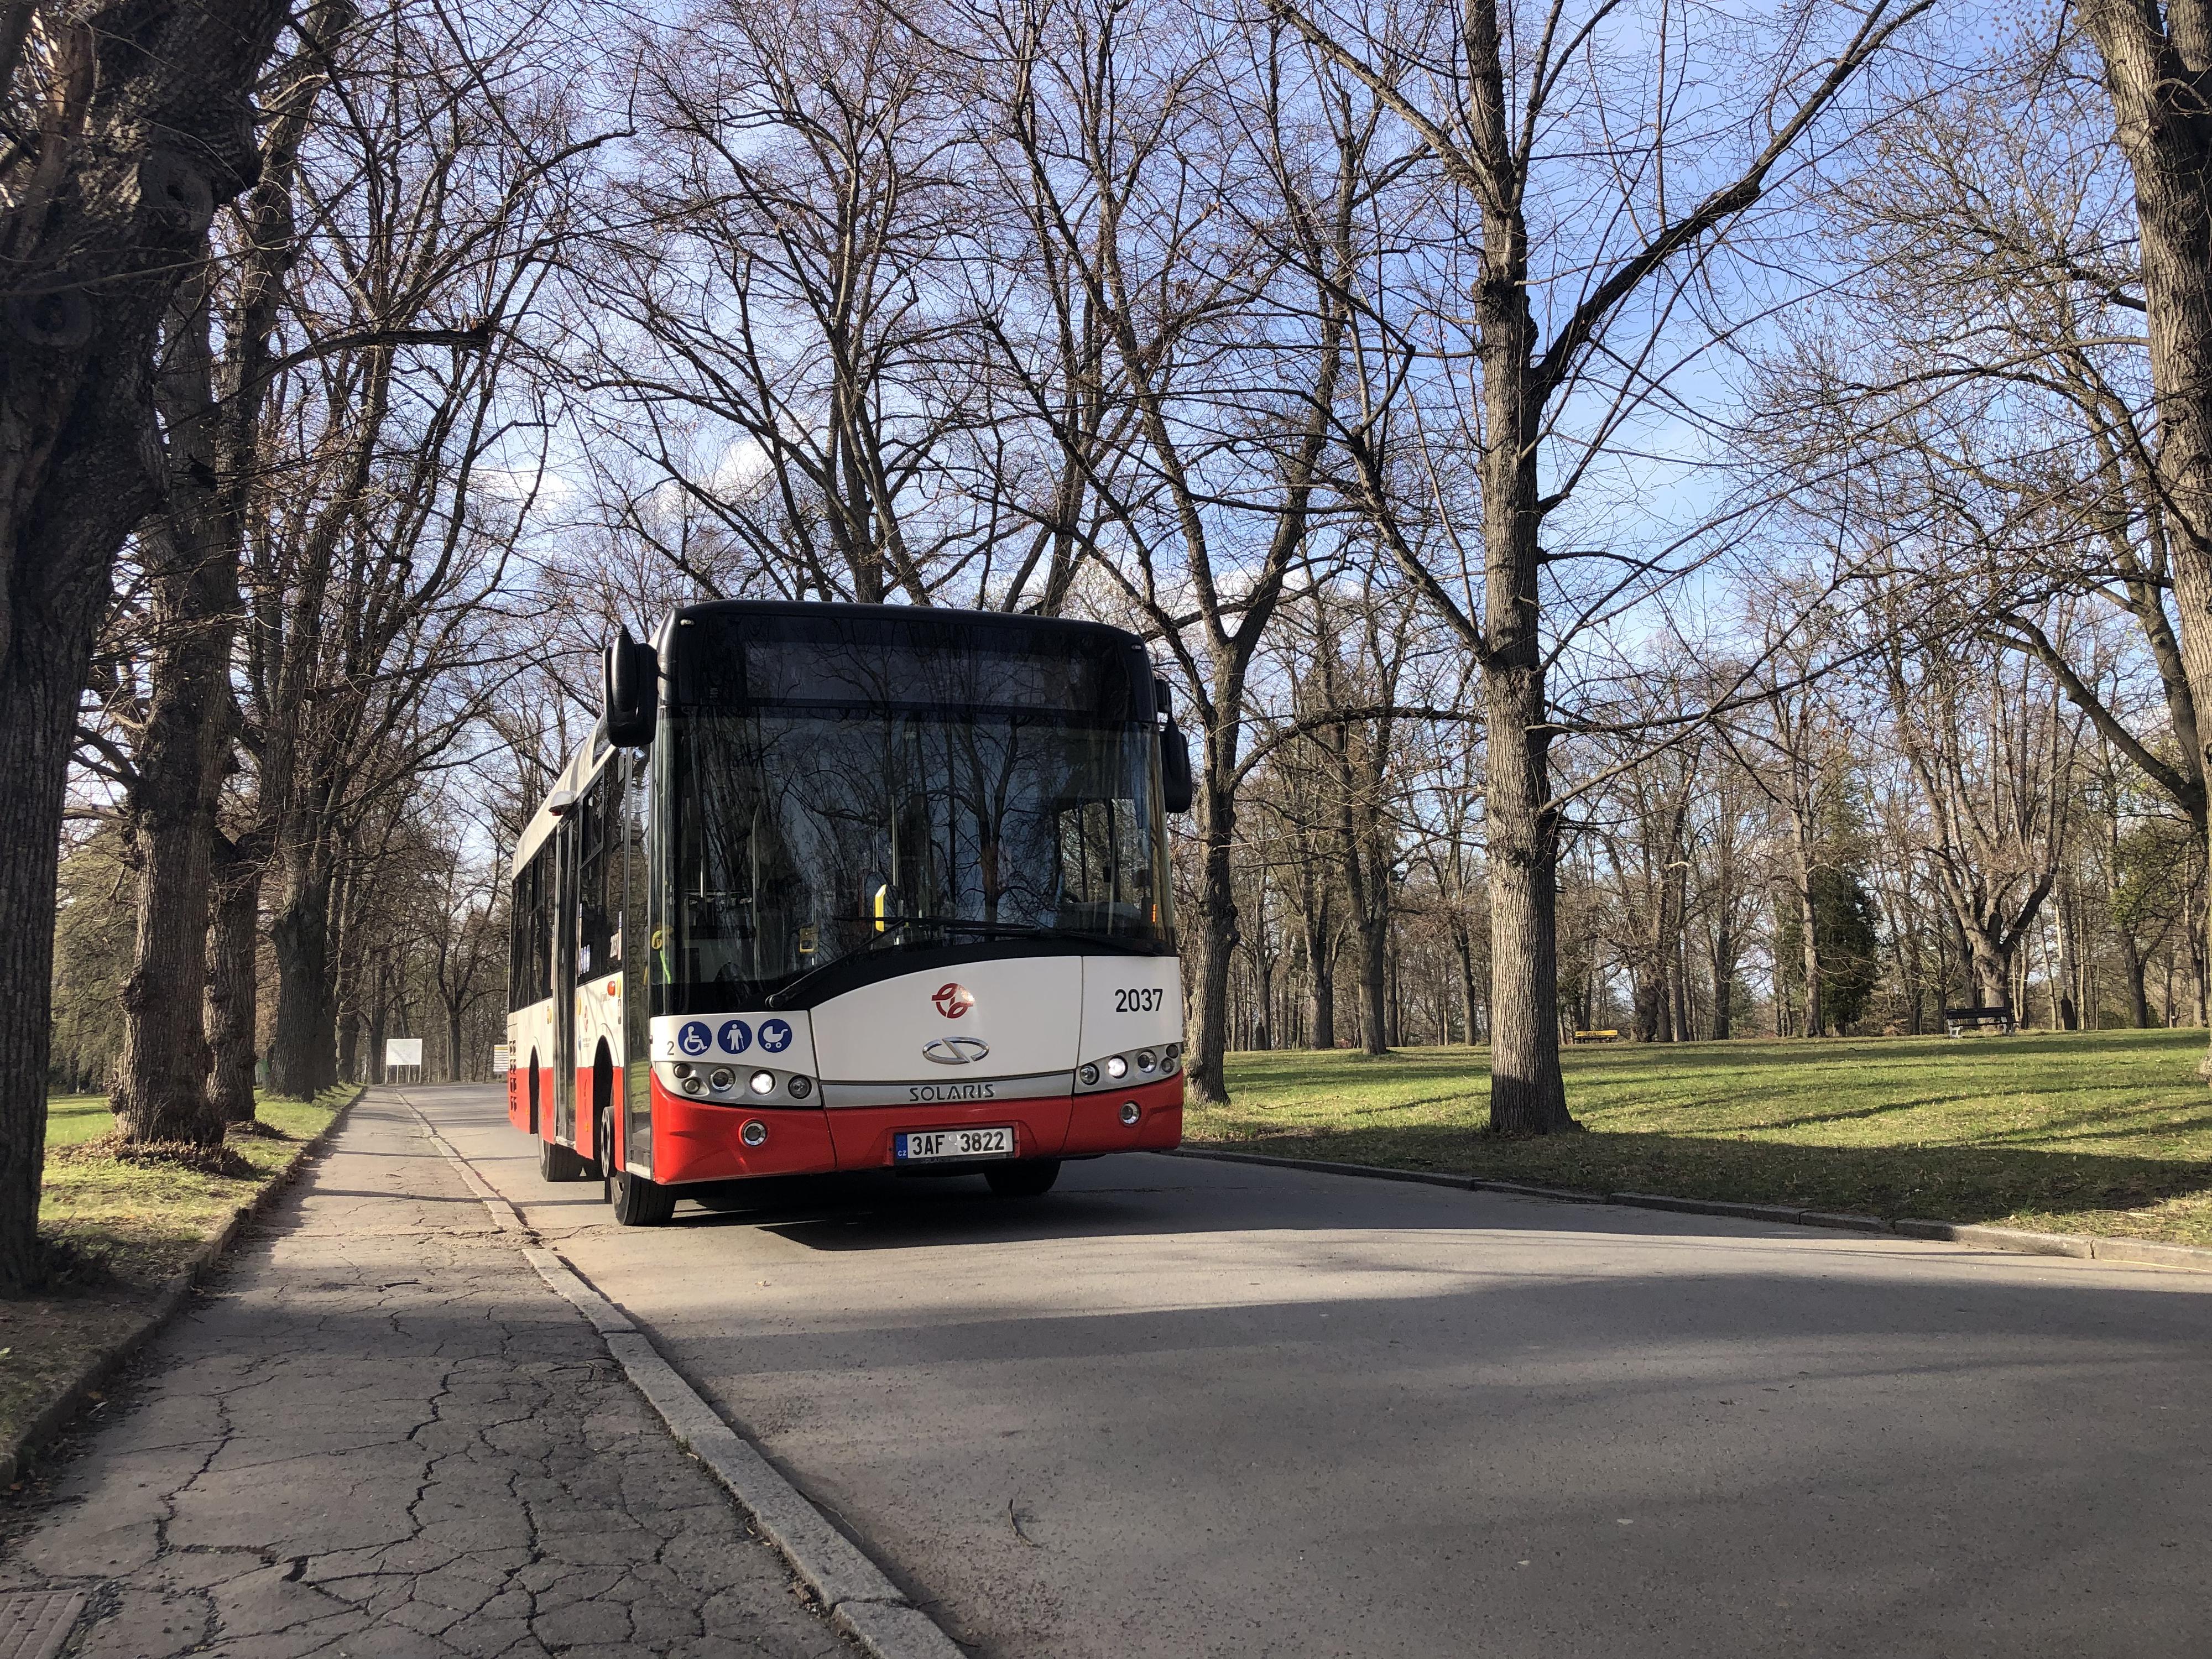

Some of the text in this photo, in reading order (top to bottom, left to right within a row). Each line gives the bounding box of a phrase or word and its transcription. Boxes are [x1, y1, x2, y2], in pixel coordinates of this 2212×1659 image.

[1115, 988, 1163, 1013] 2037
[667, 1040, 675, 1056] 2
[910, 1084, 994, 1102] SOLARIS
[912, 1134, 945, 1155] 3AF
[960, 1131, 1004, 1152] 3822
